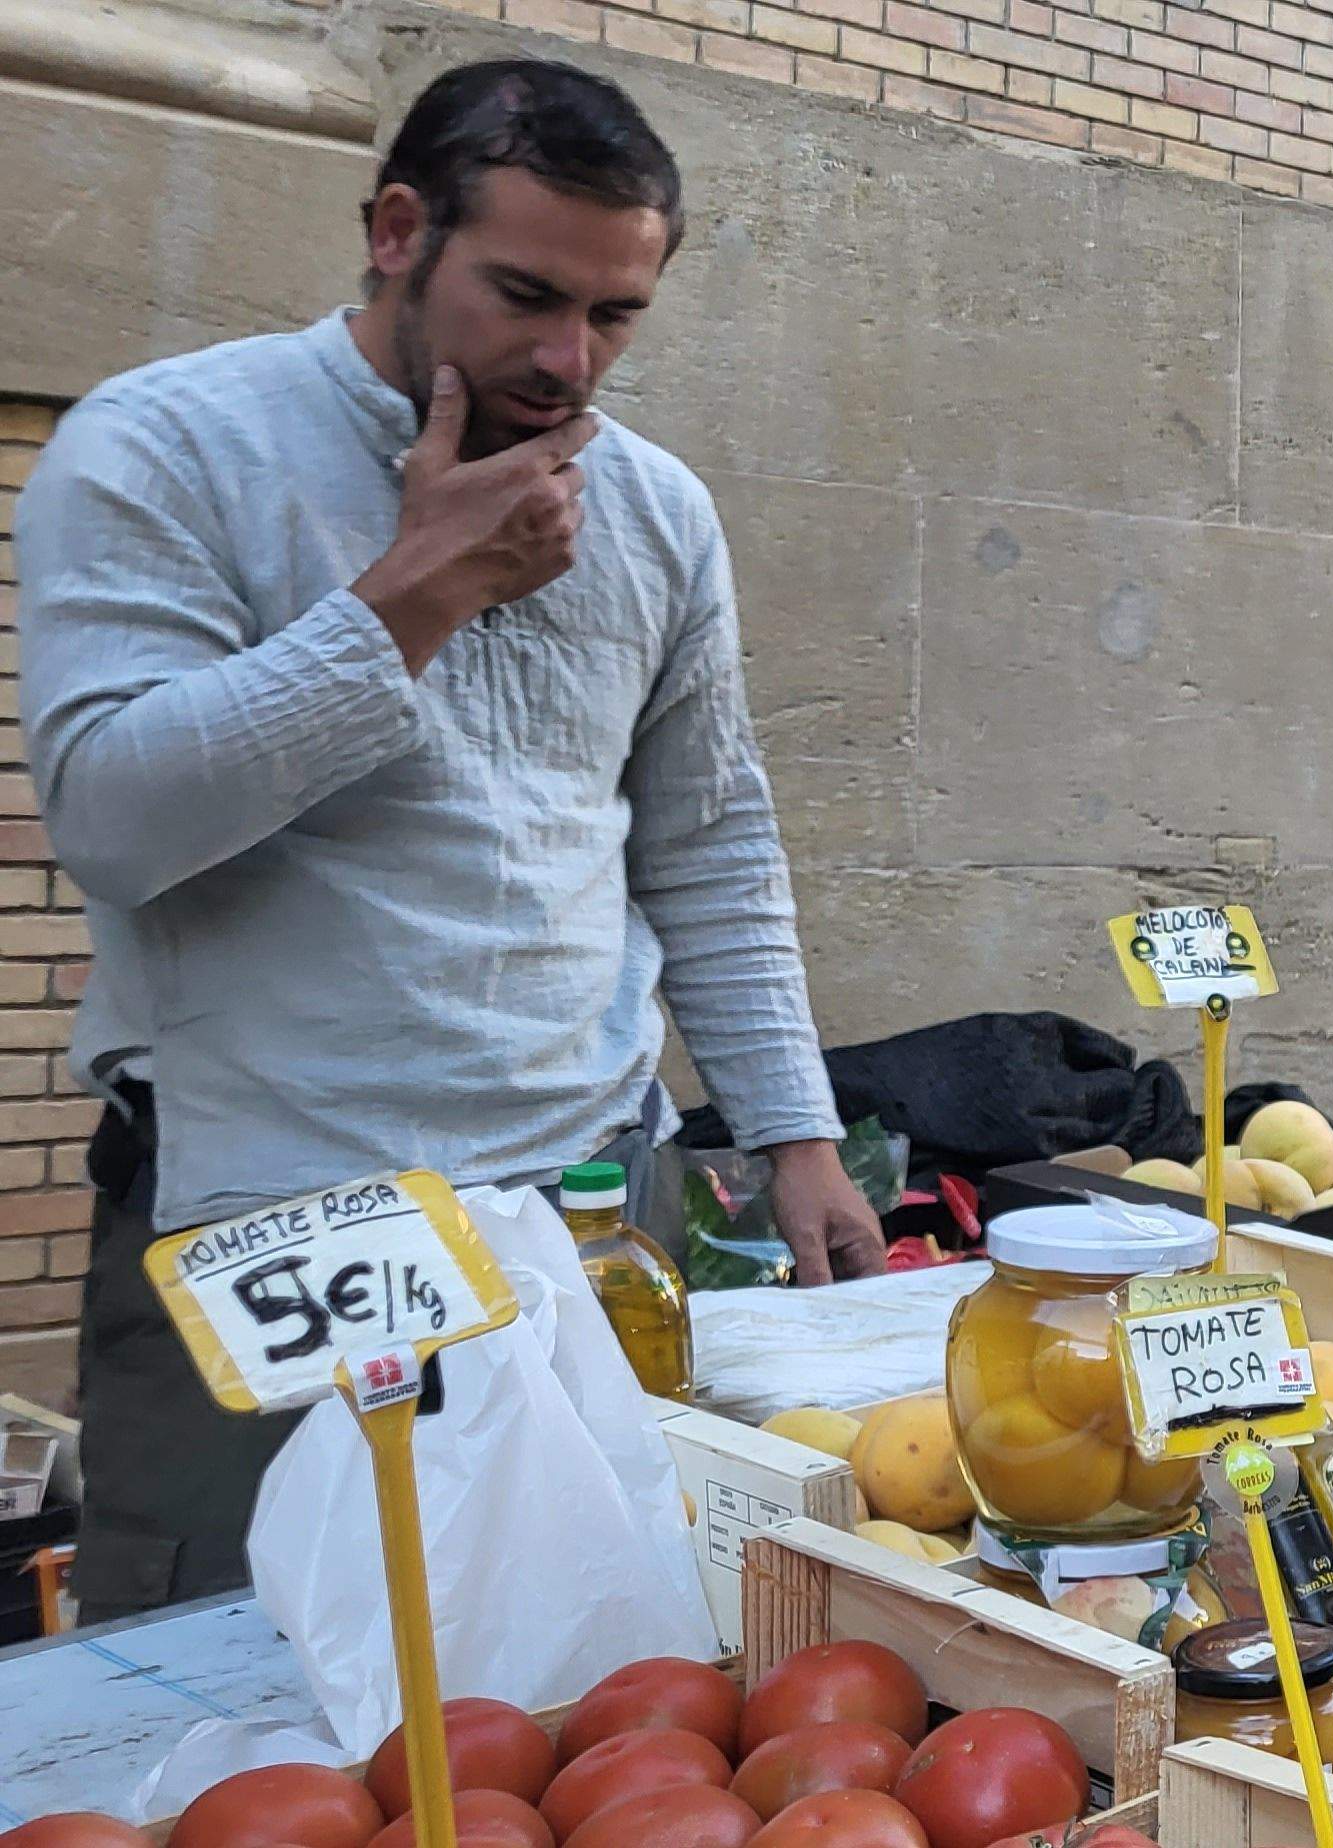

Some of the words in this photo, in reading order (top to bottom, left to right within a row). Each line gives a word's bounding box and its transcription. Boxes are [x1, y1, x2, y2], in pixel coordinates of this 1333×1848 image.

[1171, 936, 1198, 957] DE
[321, 1183, 399, 1223] ROSA
[1130, 1307, 1266, 1361] TOMATE
[1171, 1351, 1267, 1404] ROSA
[1206, 1430, 1240, 1465] Tomate
[1246, 1426, 1274, 1452] Rosa
[1236, 1470, 1272, 1490] CORREAS
